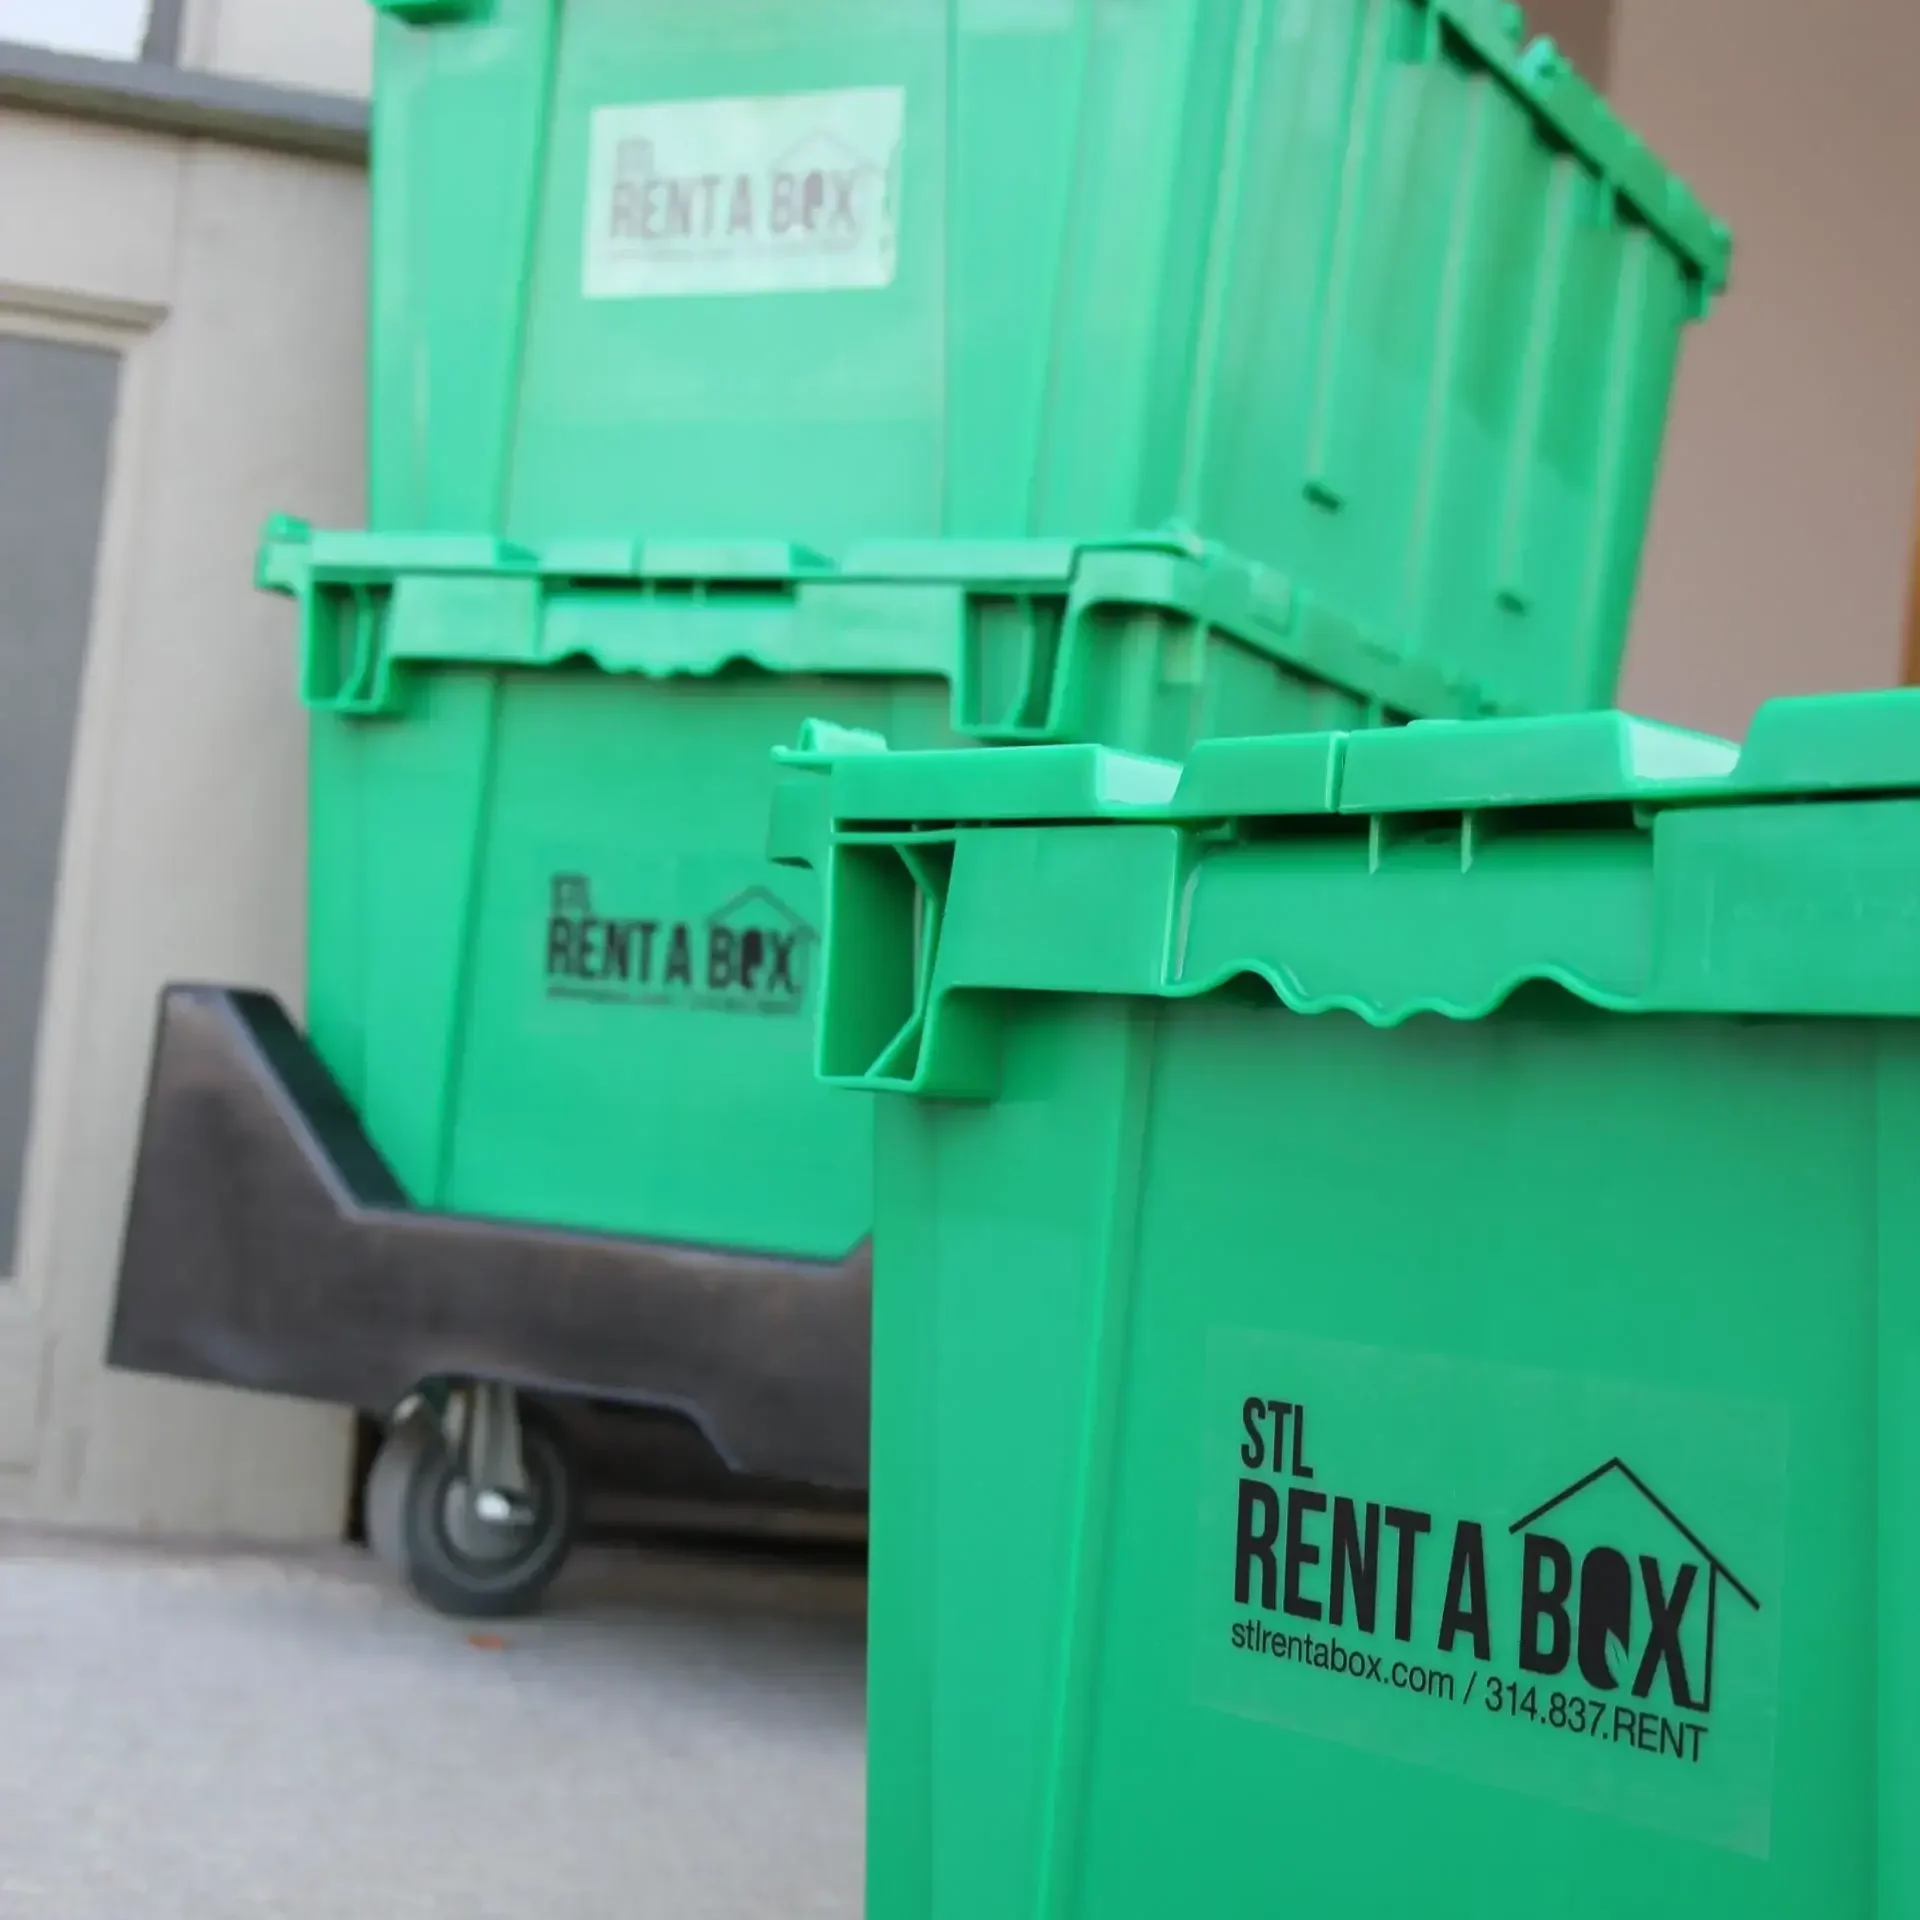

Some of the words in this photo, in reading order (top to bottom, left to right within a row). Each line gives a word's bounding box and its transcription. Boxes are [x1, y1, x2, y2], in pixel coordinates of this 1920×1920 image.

[611, 174, 722, 239] RENT
[727, 172, 754, 236] A
[547, 918, 657, 983] RENT
[666, 922, 692, 985] A
[708, 925, 794, 994] BOX
[1241, 1397, 1314, 1478] STL
[1234, 1478, 1431, 1642] RENT
[1437, 1520, 1491, 1661] A
[1518, 1532, 1698, 1710] BOX
[1231, 1620, 1455, 1701] stlrentabox.com
[1485, 1675, 1709, 1763] 314.837.RENT
